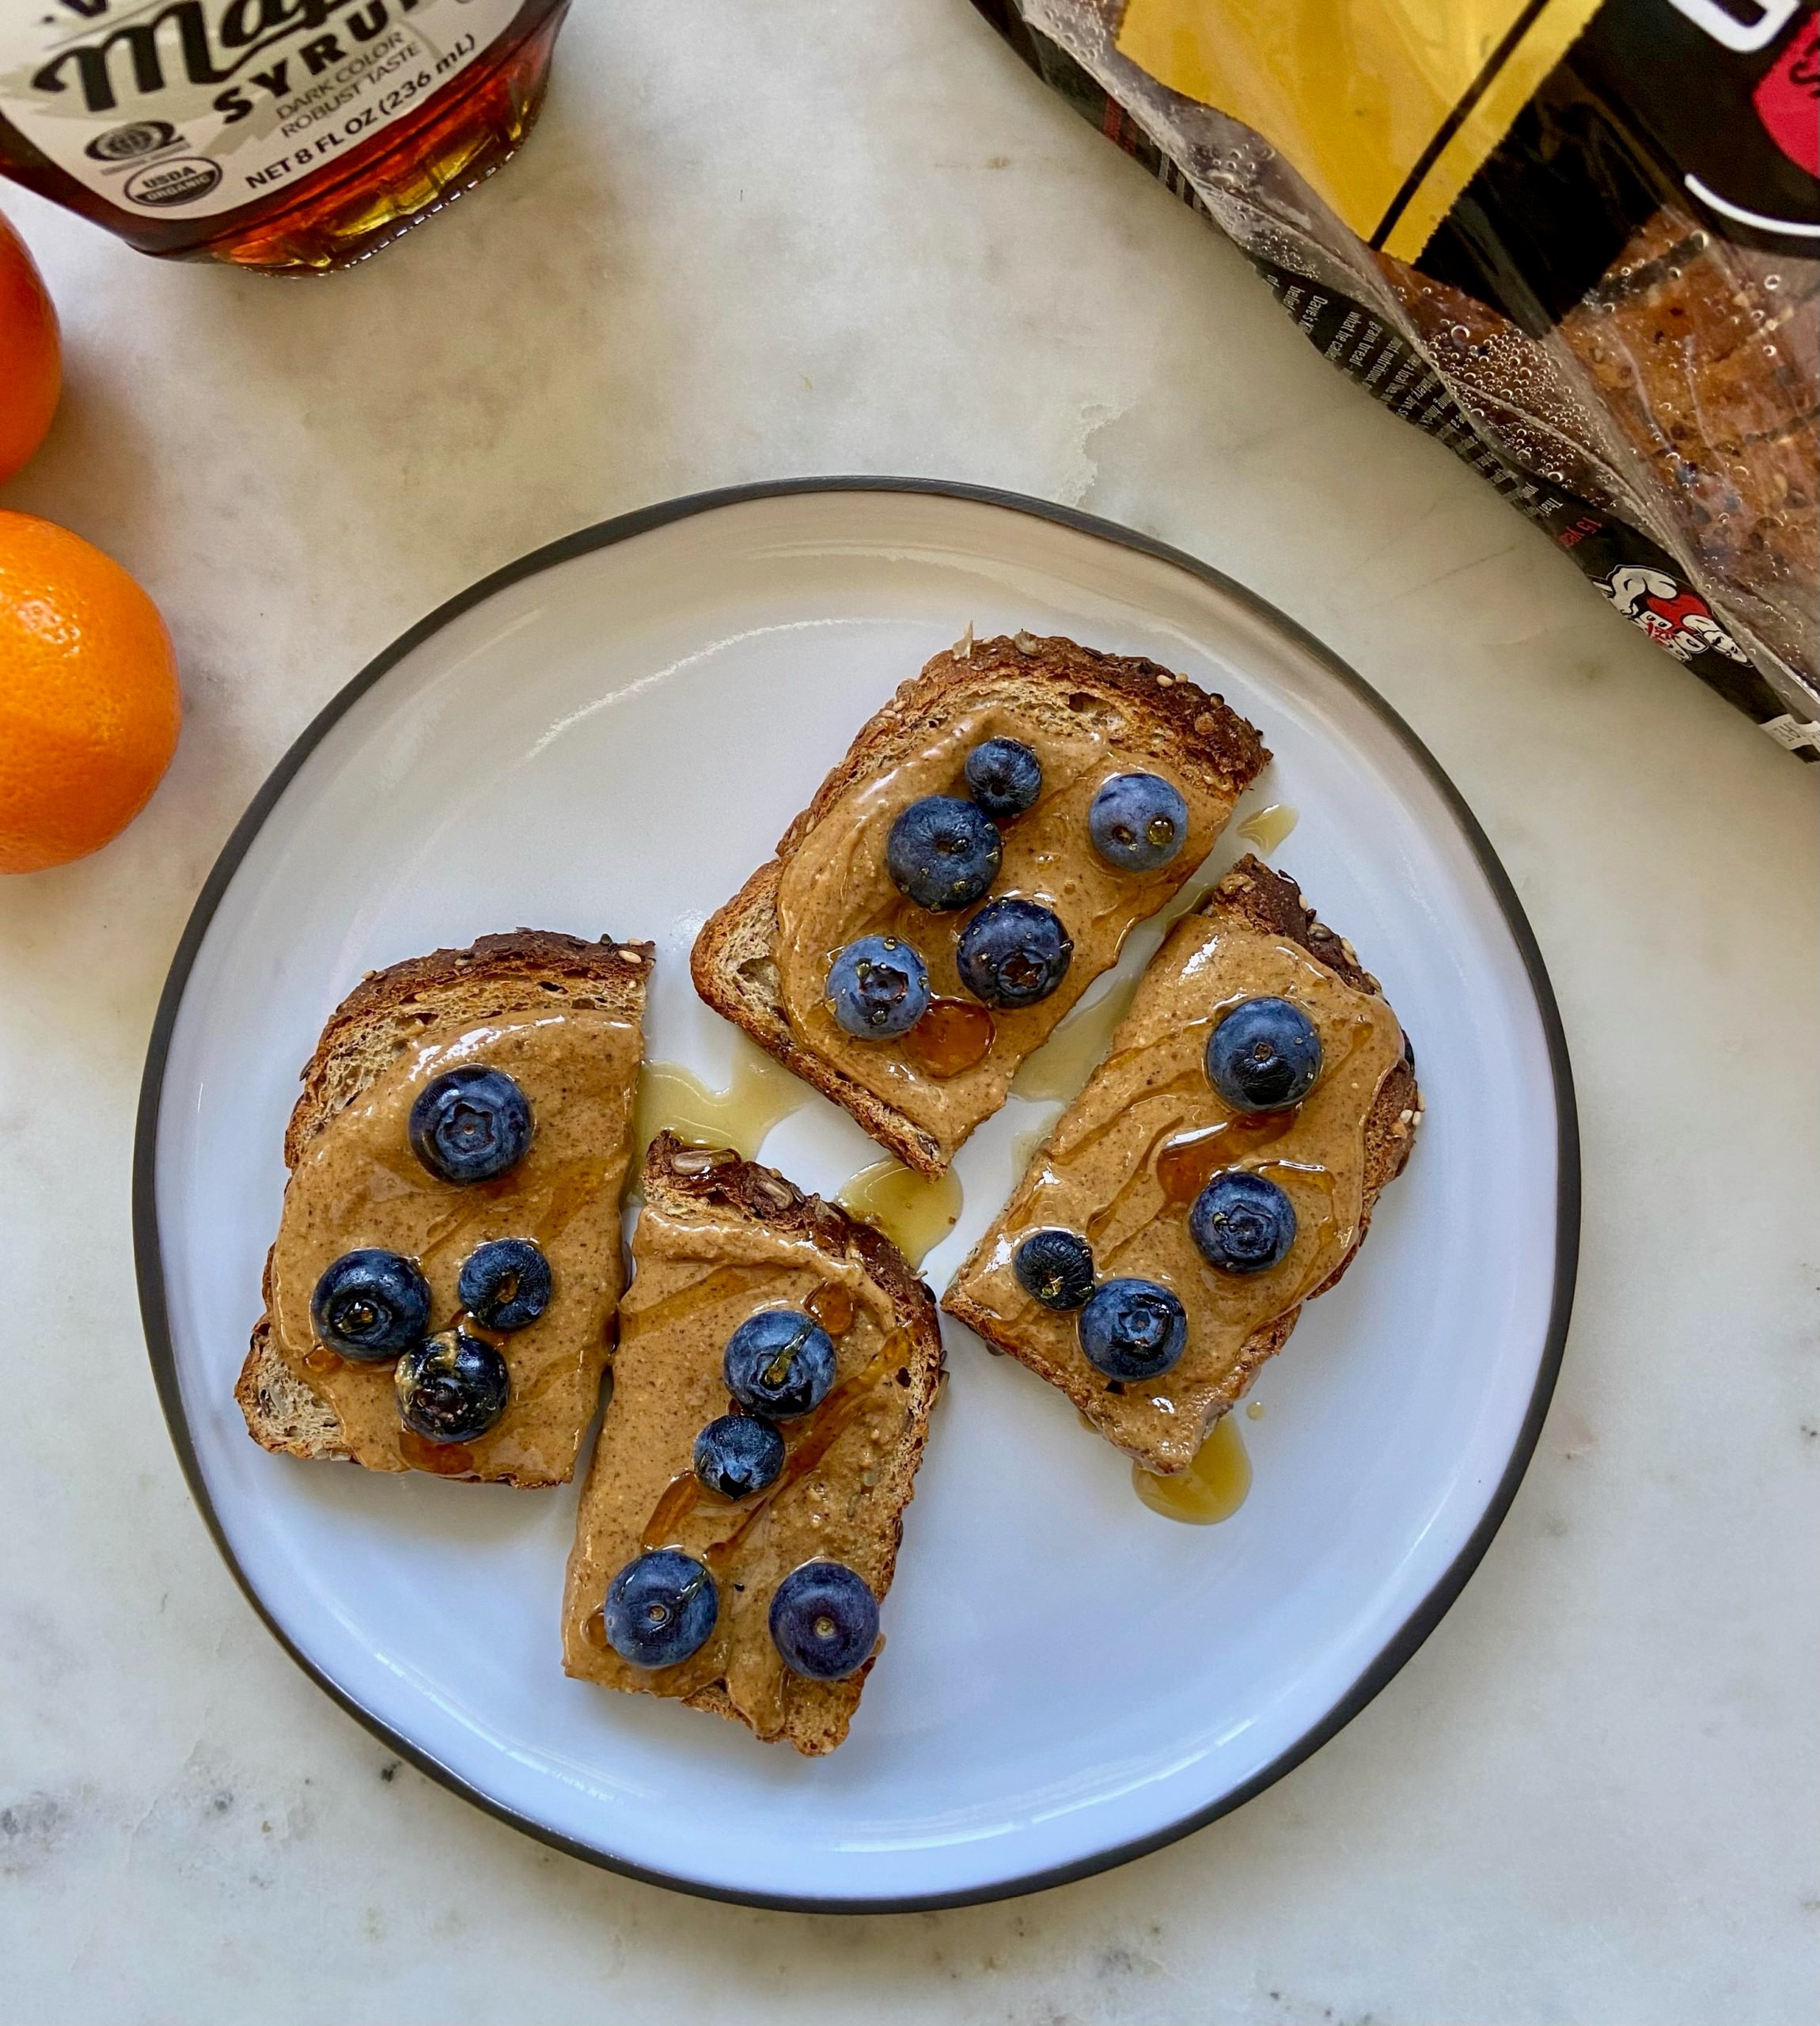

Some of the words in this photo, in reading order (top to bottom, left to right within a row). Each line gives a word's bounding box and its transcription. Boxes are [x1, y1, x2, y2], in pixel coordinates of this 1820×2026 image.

[277, 83, 336, 120] DARK
[335, 31, 404, 83] COLOR
[280, 82, 362, 138] ROBUST
[366, 43, 422, 85] TASTE
[245, 157, 292, 189] NET
[294, 148, 314, 165] 8
[316, 131, 345, 154] FL
[344, 107, 378, 135] OZ
[378, 70, 432, 116] (236
[434, 32, 476, 76] mL)
[142, 166, 197, 188] USDA
[146, 174, 210, 200] ORGANIC
[1302, 295, 1329, 321] Dave's
[1340, 311, 1361, 332] what
[1362, 321, 1383, 342] grain
[1335, 330, 1353, 342] he
[1348, 342, 1374, 367] bread
[1393, 369, 1414, 385] loaf
[1575, 517, 1602, 535] 15
